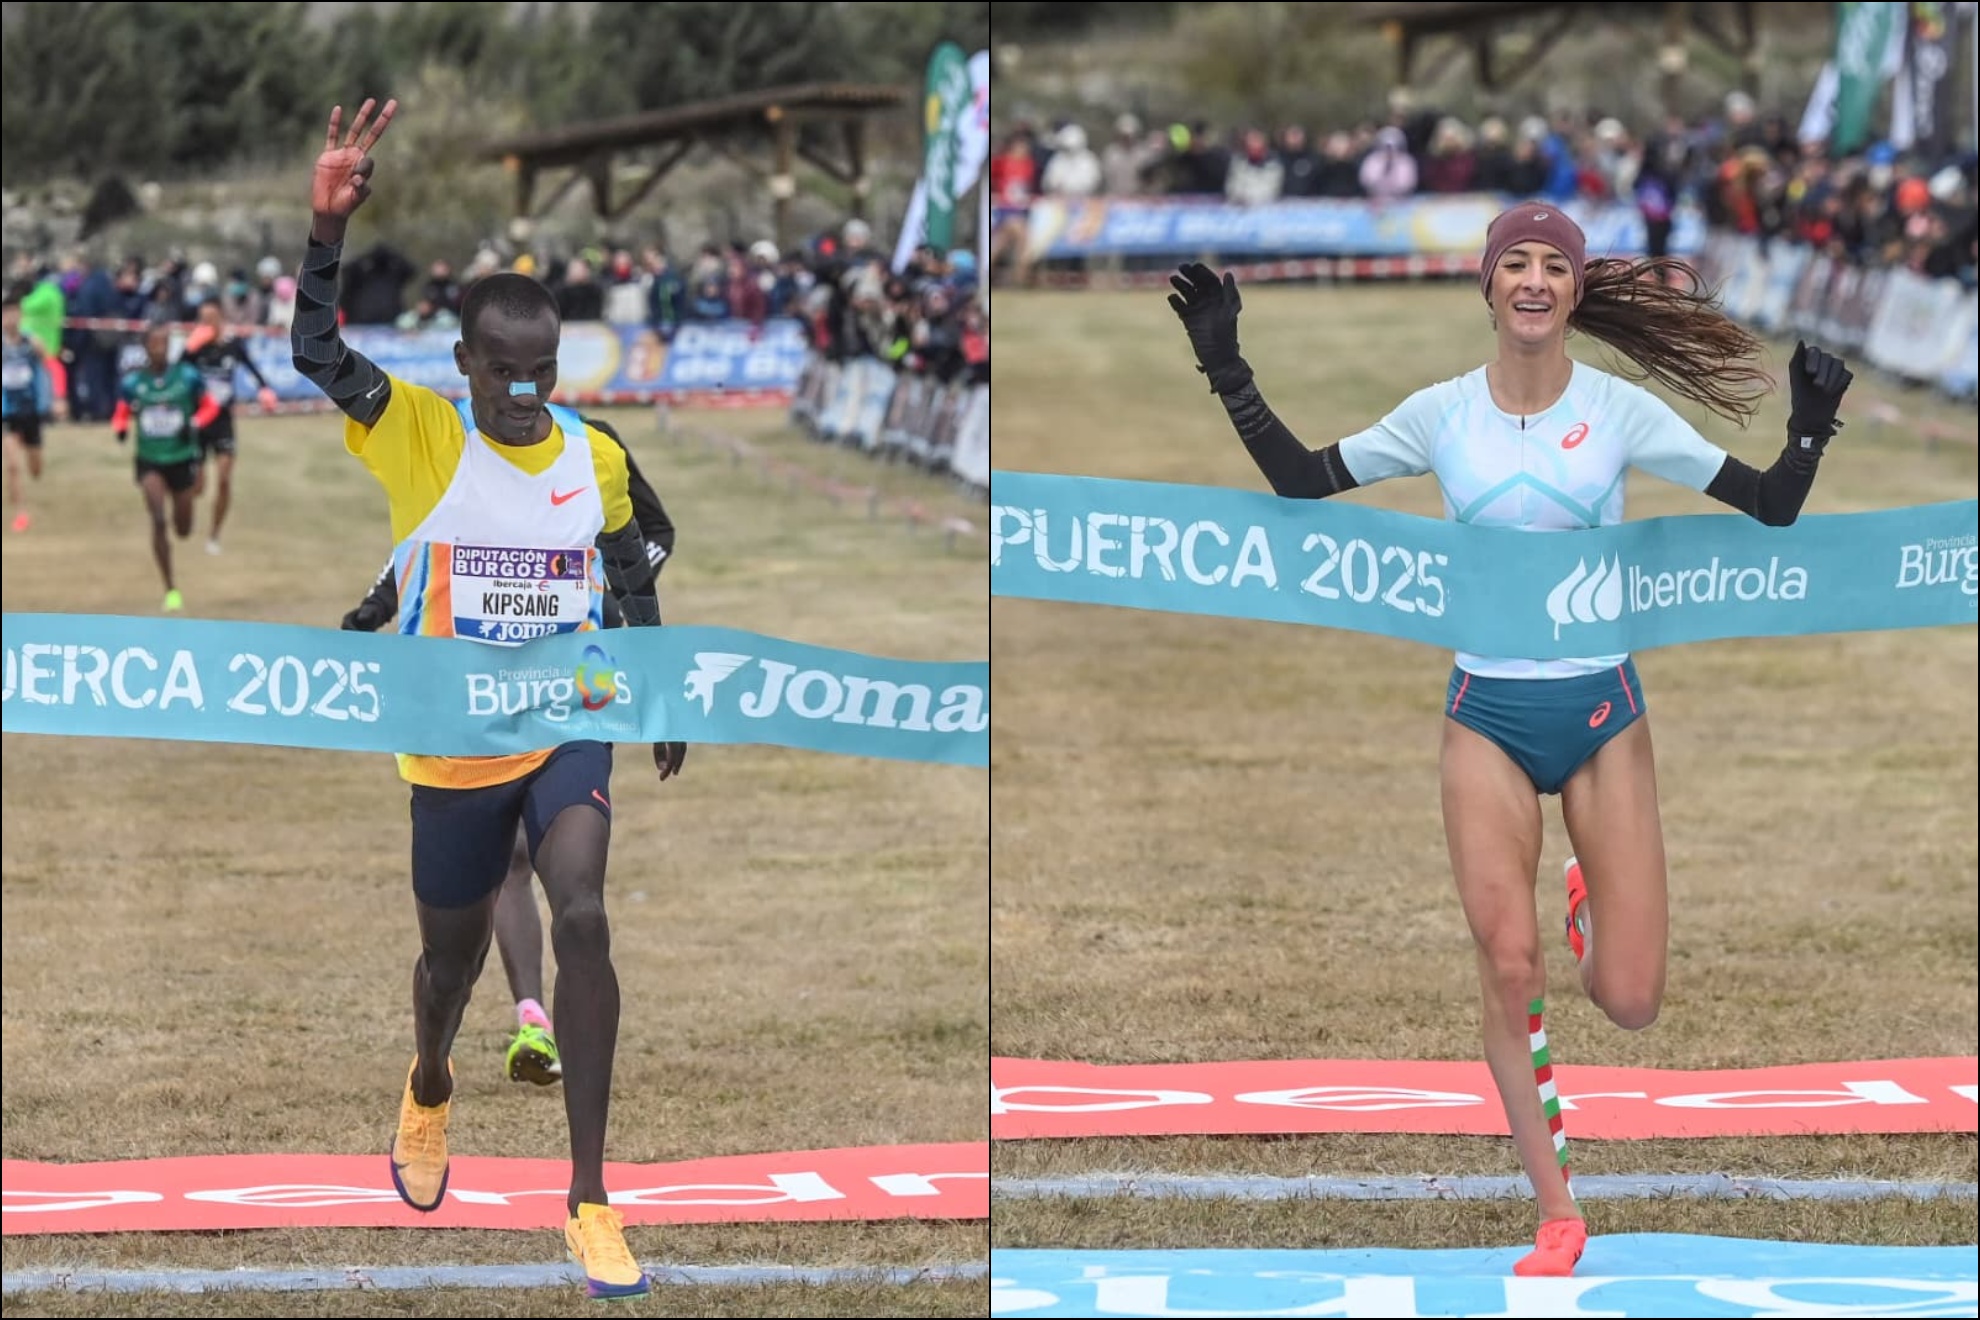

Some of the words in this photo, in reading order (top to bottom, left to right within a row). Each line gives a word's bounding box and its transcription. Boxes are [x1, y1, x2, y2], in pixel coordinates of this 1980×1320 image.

[1926, 533, 1977, 551] Provincia
[455, 548, 547, 563] DIPUTACIÓN
[990, 505, 1280, 592] PUERCA
[1299, 533, 1451, 618] 2025
[455, 560, 547, 578] BURGOS
[493, 579, 532, 591] Ibercaja
[1628, 556, 1809, 614] Iberdrola
[482, 592, 559, 617] KIPSANG
[500, 666, 560, 681] Provincia
[226, 653, 382, 722] 2025
[739, 659, 989, 732] Joma
